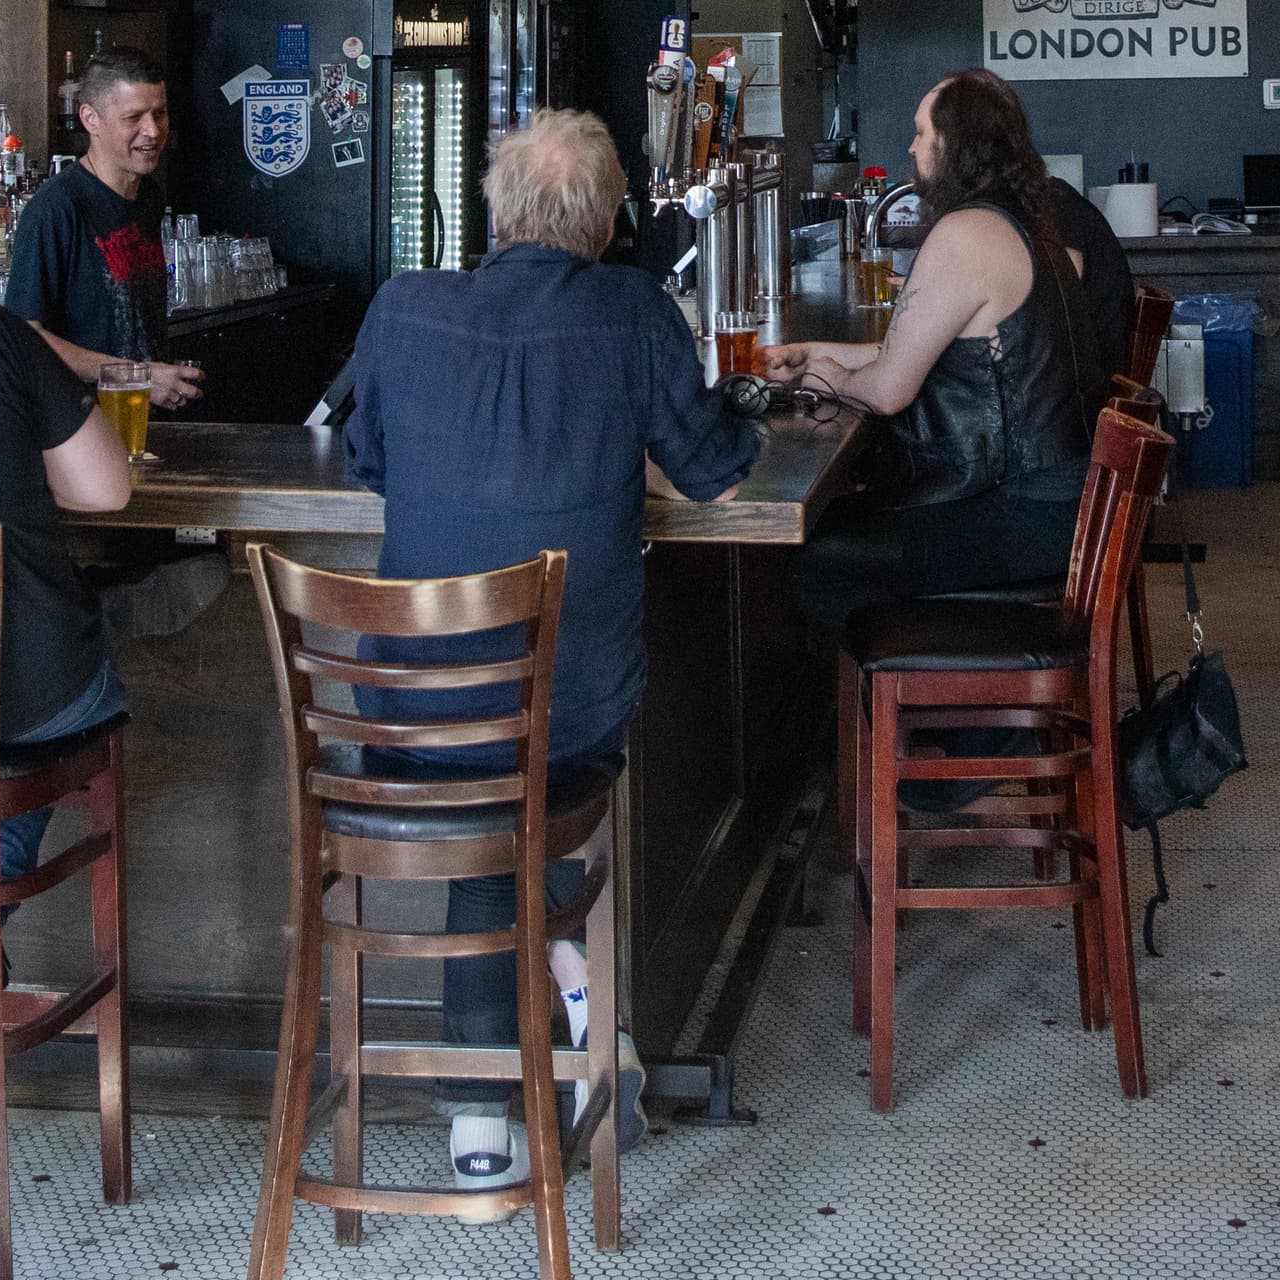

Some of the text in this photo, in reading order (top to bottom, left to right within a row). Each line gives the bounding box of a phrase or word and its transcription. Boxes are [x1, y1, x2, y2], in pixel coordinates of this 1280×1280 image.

[1084, 1, 1145, 14] DIRIGE
[990, 26, 1242, 60] LONDON PUB
[249, 84, 303, 95] ENGLAND
